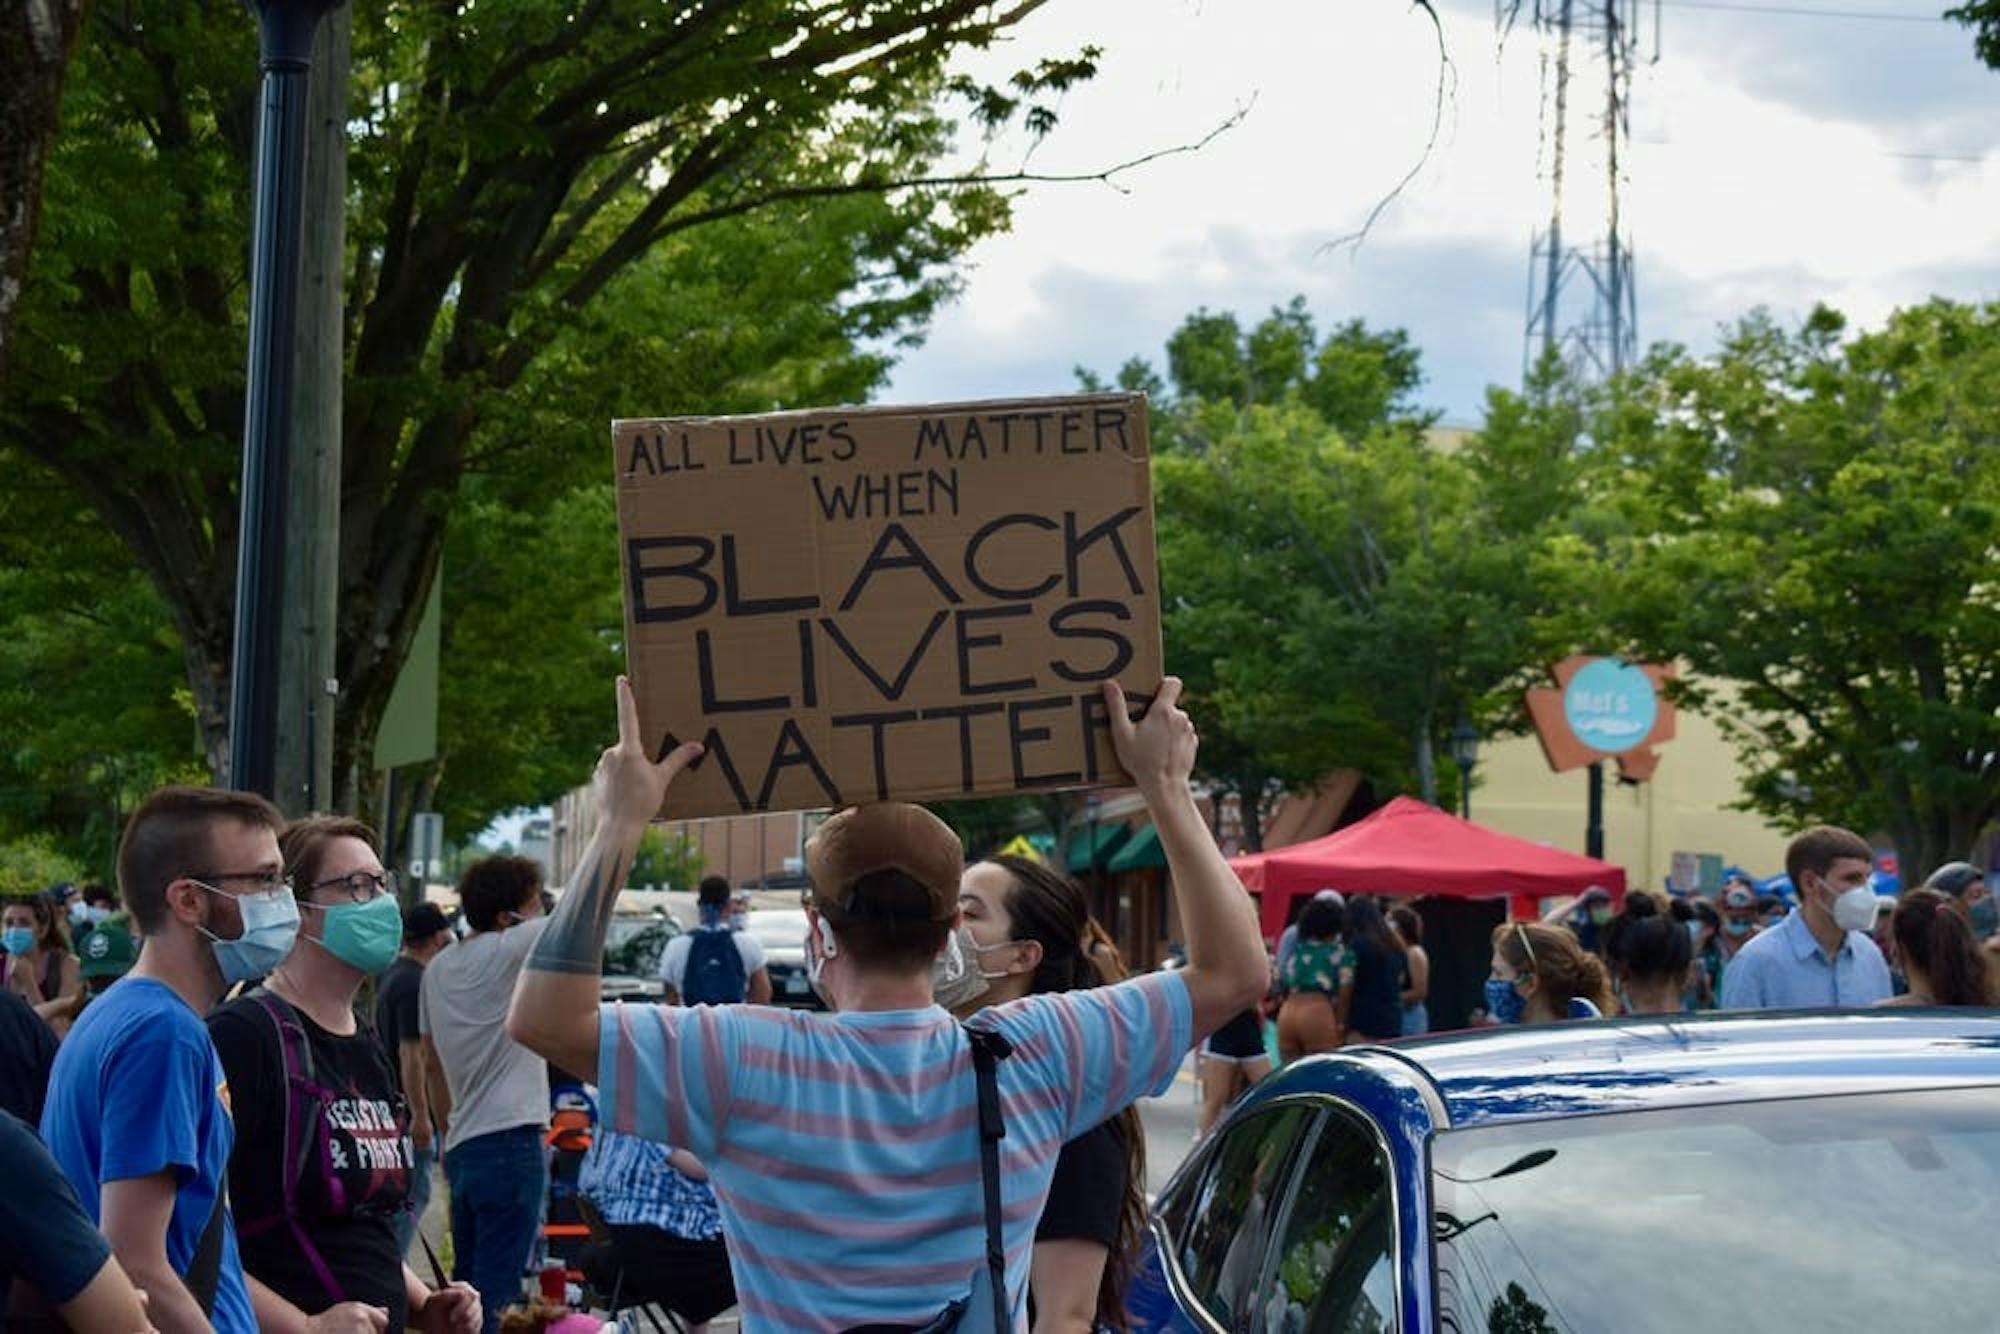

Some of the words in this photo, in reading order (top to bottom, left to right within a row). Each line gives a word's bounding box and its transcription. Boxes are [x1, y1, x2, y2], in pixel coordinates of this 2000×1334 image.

[628, 433, 705, 475] ALL
[729, 421, 857, 465] LIVES
[914, 408, 1130, 460] MATTER
[812, 468, 959, 520] WHEN
[627, 506, 1144, 624] BLACK
[696, 600, 1134, 714] LIVES
[329, 1138, 349, 1169] &
[355, 1137, 402, 1169] FIGHT
